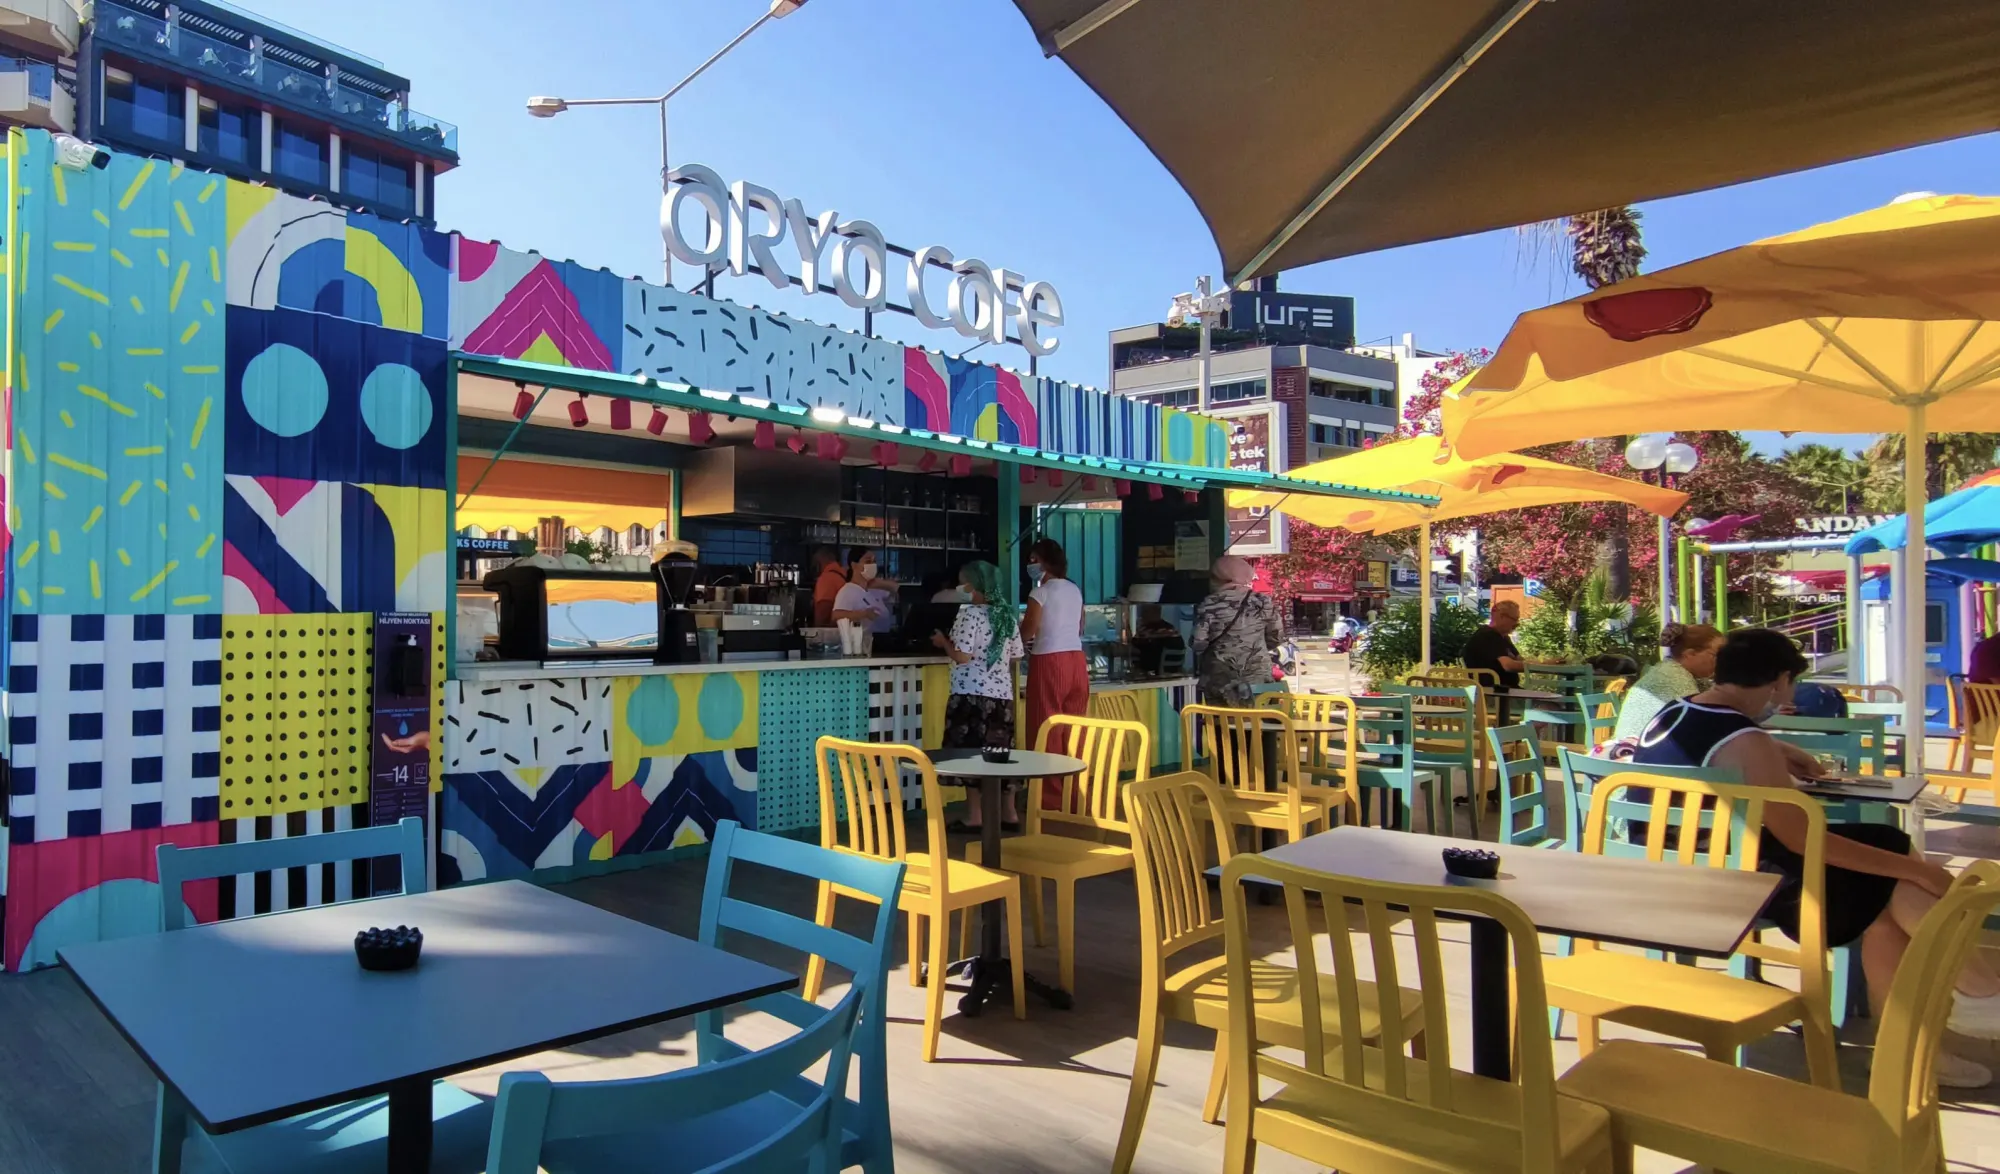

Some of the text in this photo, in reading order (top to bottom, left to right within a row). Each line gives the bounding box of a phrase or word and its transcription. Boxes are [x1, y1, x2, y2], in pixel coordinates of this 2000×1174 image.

[1255, 297, 1334, 328] lure
[1238, 445, 1265, 459] tek
[471, 539, 509, 550] COFFEE
[403, 617, 431, 625] NOKTASI
[392, 764, 410, 783] 14
